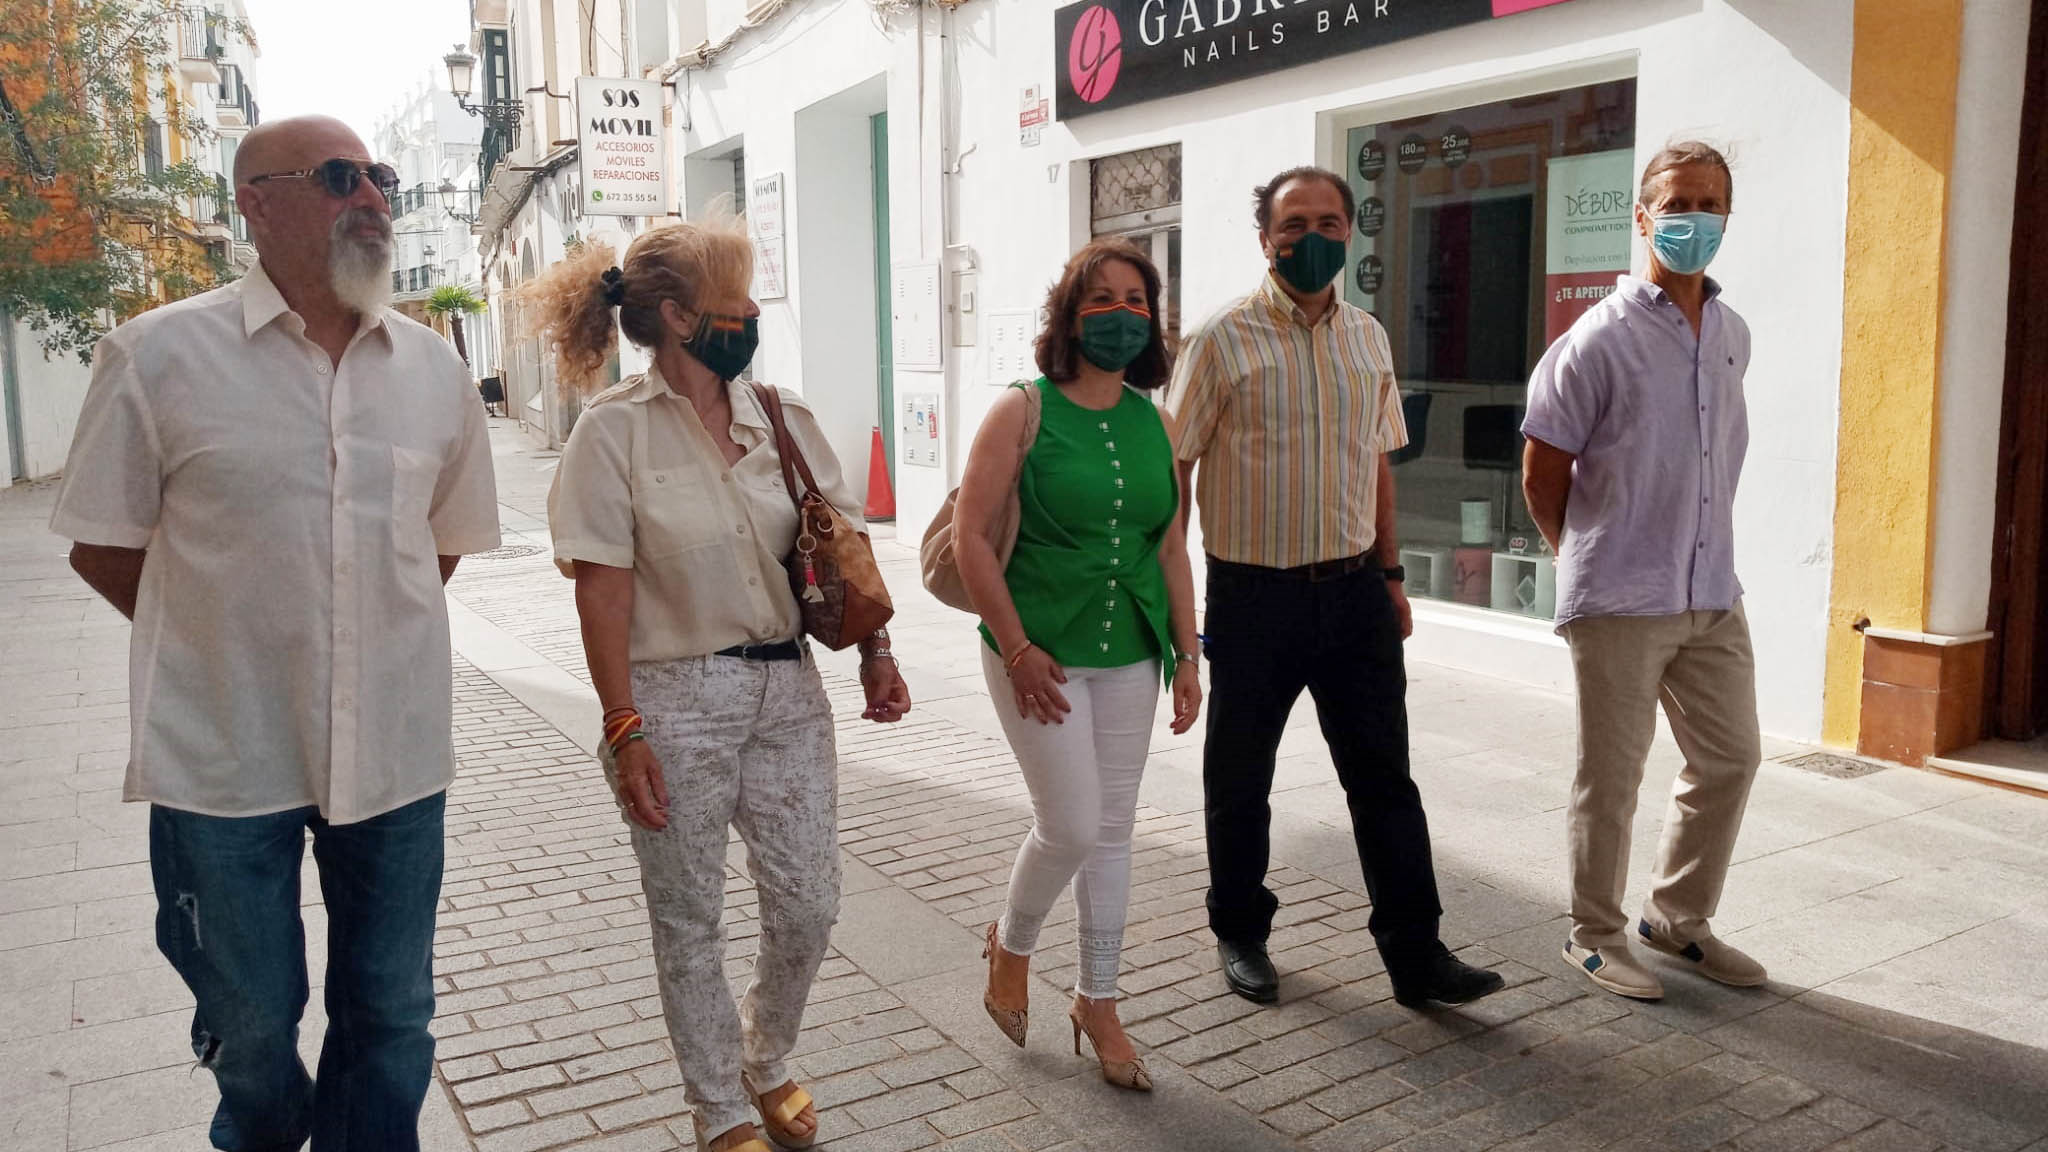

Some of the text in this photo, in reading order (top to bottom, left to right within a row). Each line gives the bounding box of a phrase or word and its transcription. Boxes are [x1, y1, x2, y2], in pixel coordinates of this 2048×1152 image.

[1183, 0, 1389, 68] NAILS BAR
[602, 88, 640, 108] SOS
[589, 117, 658, 137] MOVIL
[595, 141, 655, 153] ACCESORIOS
[606, 156, 646, 167] MOVILES
[593, 169, 660, 181] REPARACIONES
[1048, 163, 1061, 184] 17
[606, 193, 657, 203] 672 35 55 54
[1555, 287, 1573, 303] ¿TE
